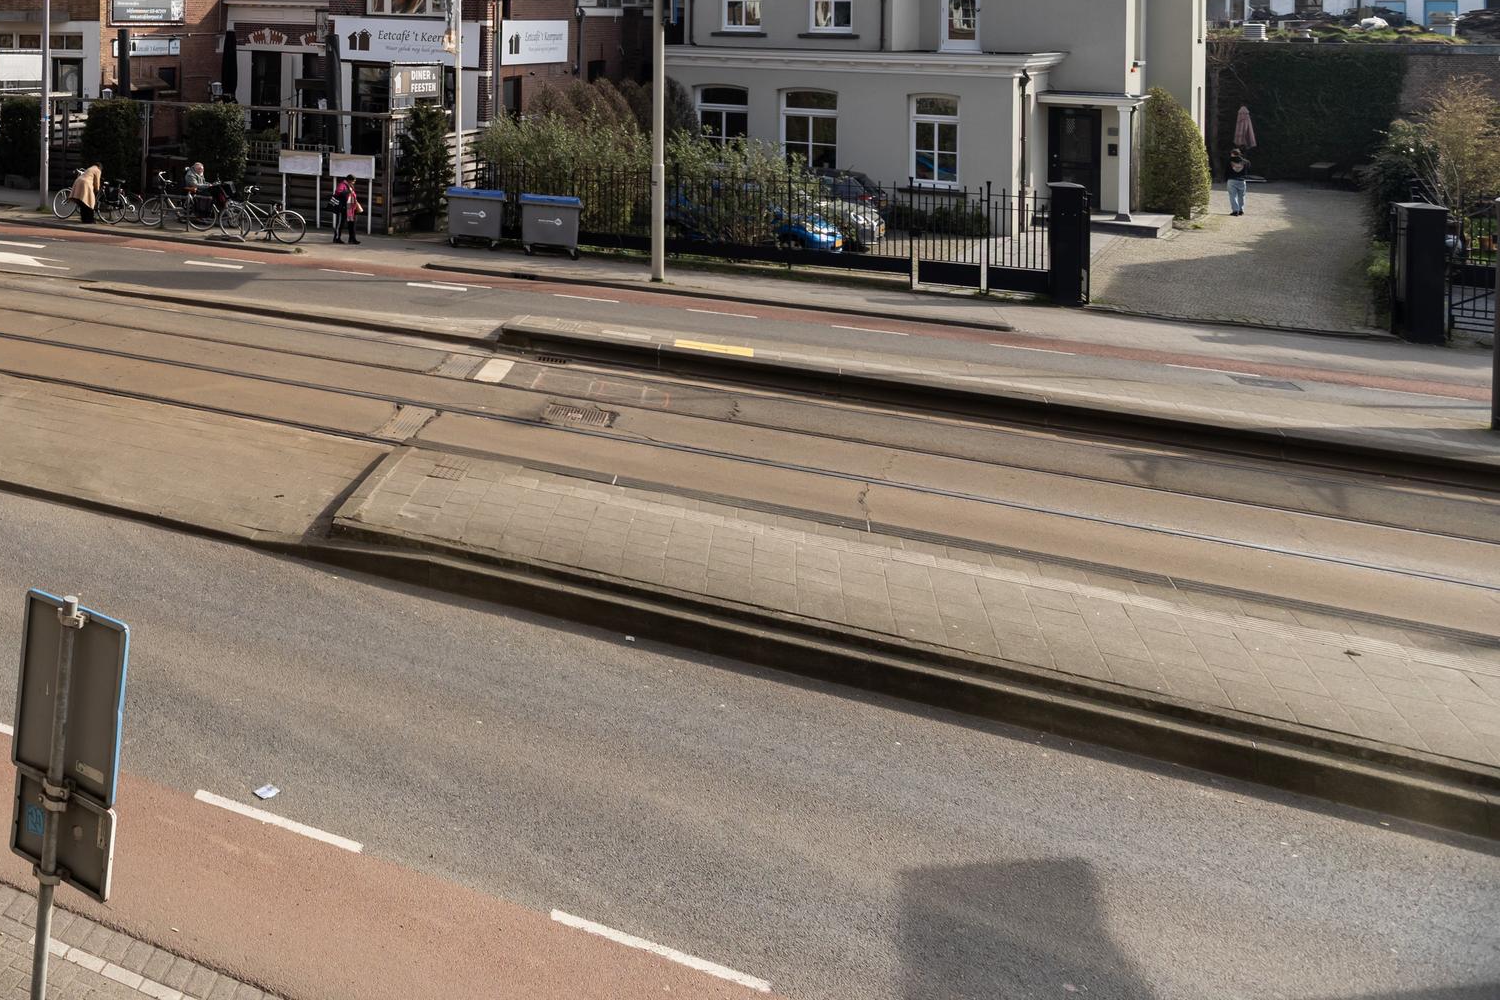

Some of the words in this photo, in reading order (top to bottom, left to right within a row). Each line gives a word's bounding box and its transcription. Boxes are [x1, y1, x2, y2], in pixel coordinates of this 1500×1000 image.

[378, 29, 411, 45] Eetcafé
[411, 70, 431, 81] DINER
[411, 82, 436, 93] FEESTEN
